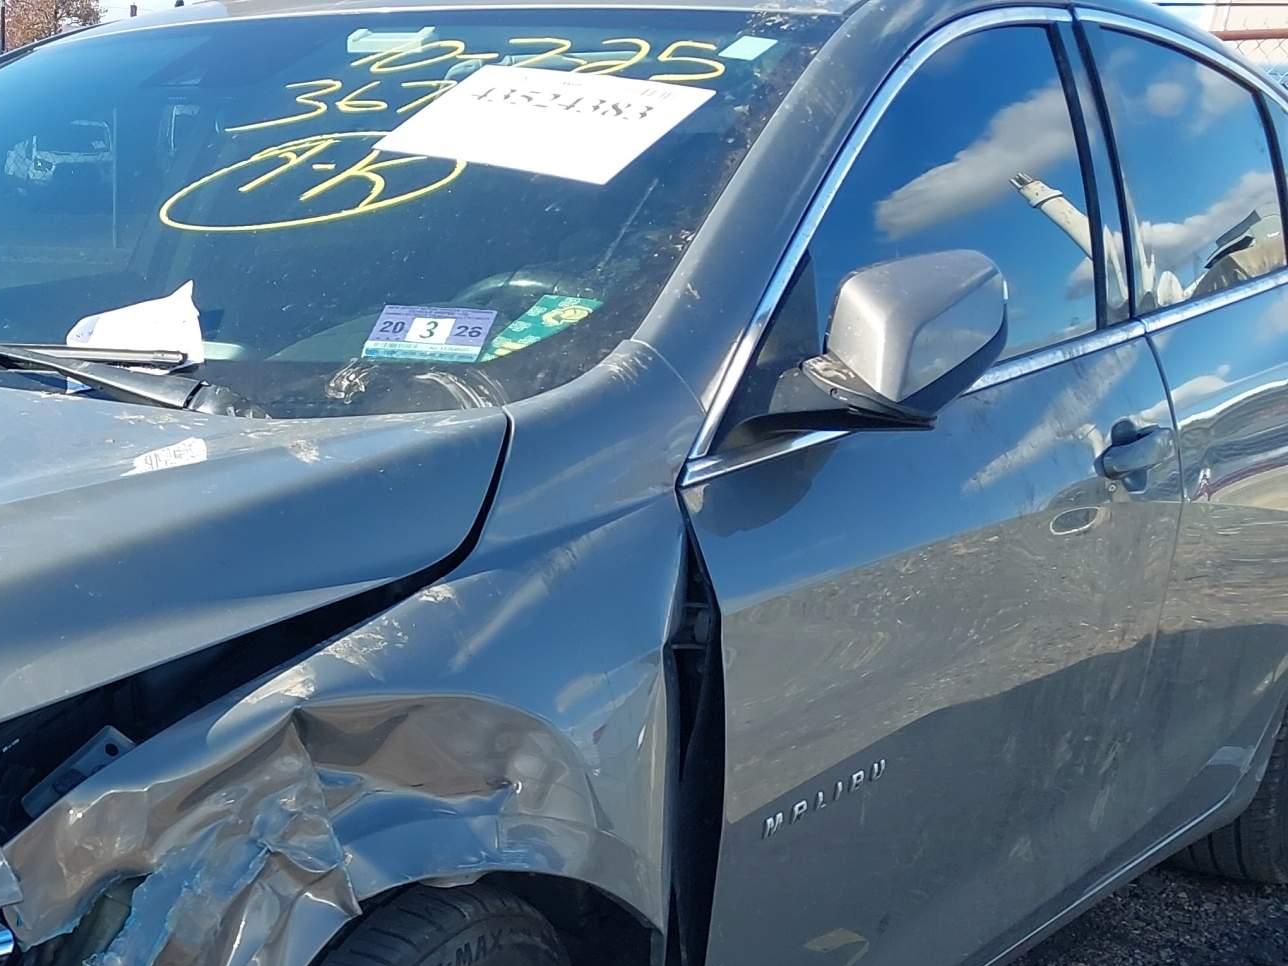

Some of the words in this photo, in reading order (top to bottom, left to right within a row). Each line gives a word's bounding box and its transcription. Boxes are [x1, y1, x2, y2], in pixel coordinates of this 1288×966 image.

[379, 320, 406, 334] 20
[418, 320, 440, 339] 3
[454, 325, 484, 338] 26
[762, 759, 886, 839] MALIBU
